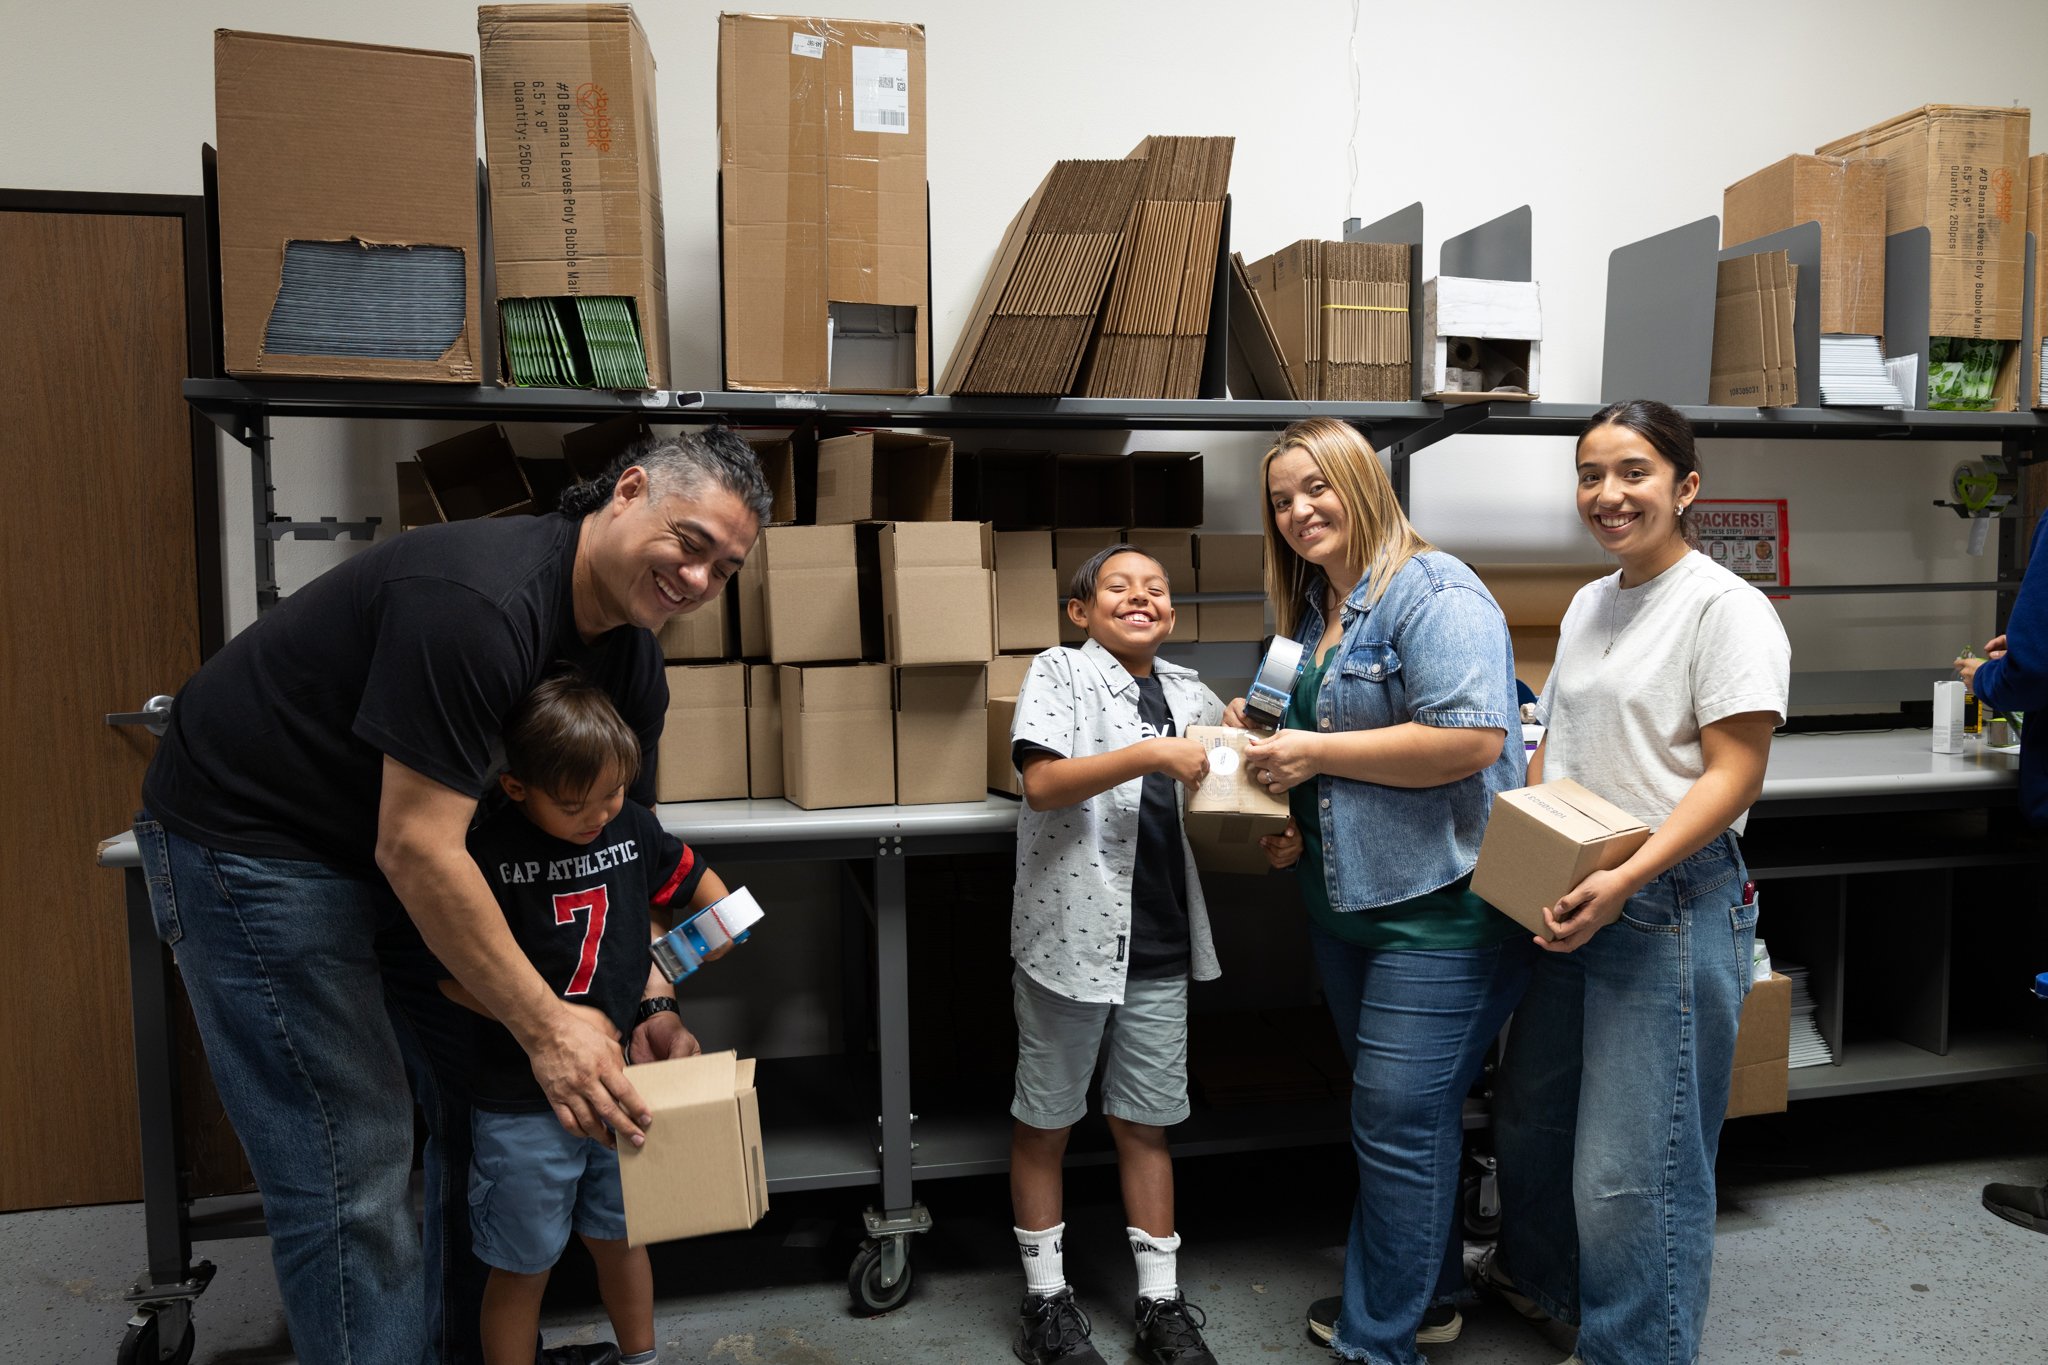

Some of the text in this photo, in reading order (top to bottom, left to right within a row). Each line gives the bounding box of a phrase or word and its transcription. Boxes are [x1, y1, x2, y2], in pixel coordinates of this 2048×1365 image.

[532, 81, 546, 105] 6.5"
[513, 81, 532, 188] Quantity: 250pcs
[536, 121, 548, 133] 9"
[583, 118, 598, 148] pak
[596, 98, 612, 152] bubble
[556, 82, 580, 296] #0 Banana Leaves Poly Bubble Mail
[1963, 166, 1972, 185] 6.5"
[1979, 167, 1988, 182] #0
[1948, 165, 1959, 249] Quantity: 250pcs
[1962, 197, 1972, 207] 9"
[1978, 185, 1987, 219] Banana
[1977, 222, 1986, 256] Leaves
[1974, 260, 1985, 279] Poly
[1975, 282, 1984, 314] Bubble
[1695, 513, 1764, 528] PACKERS!
[499, 839, 639, 884] GAP ATHLETIC
[552, 883, 609, 996] 7
